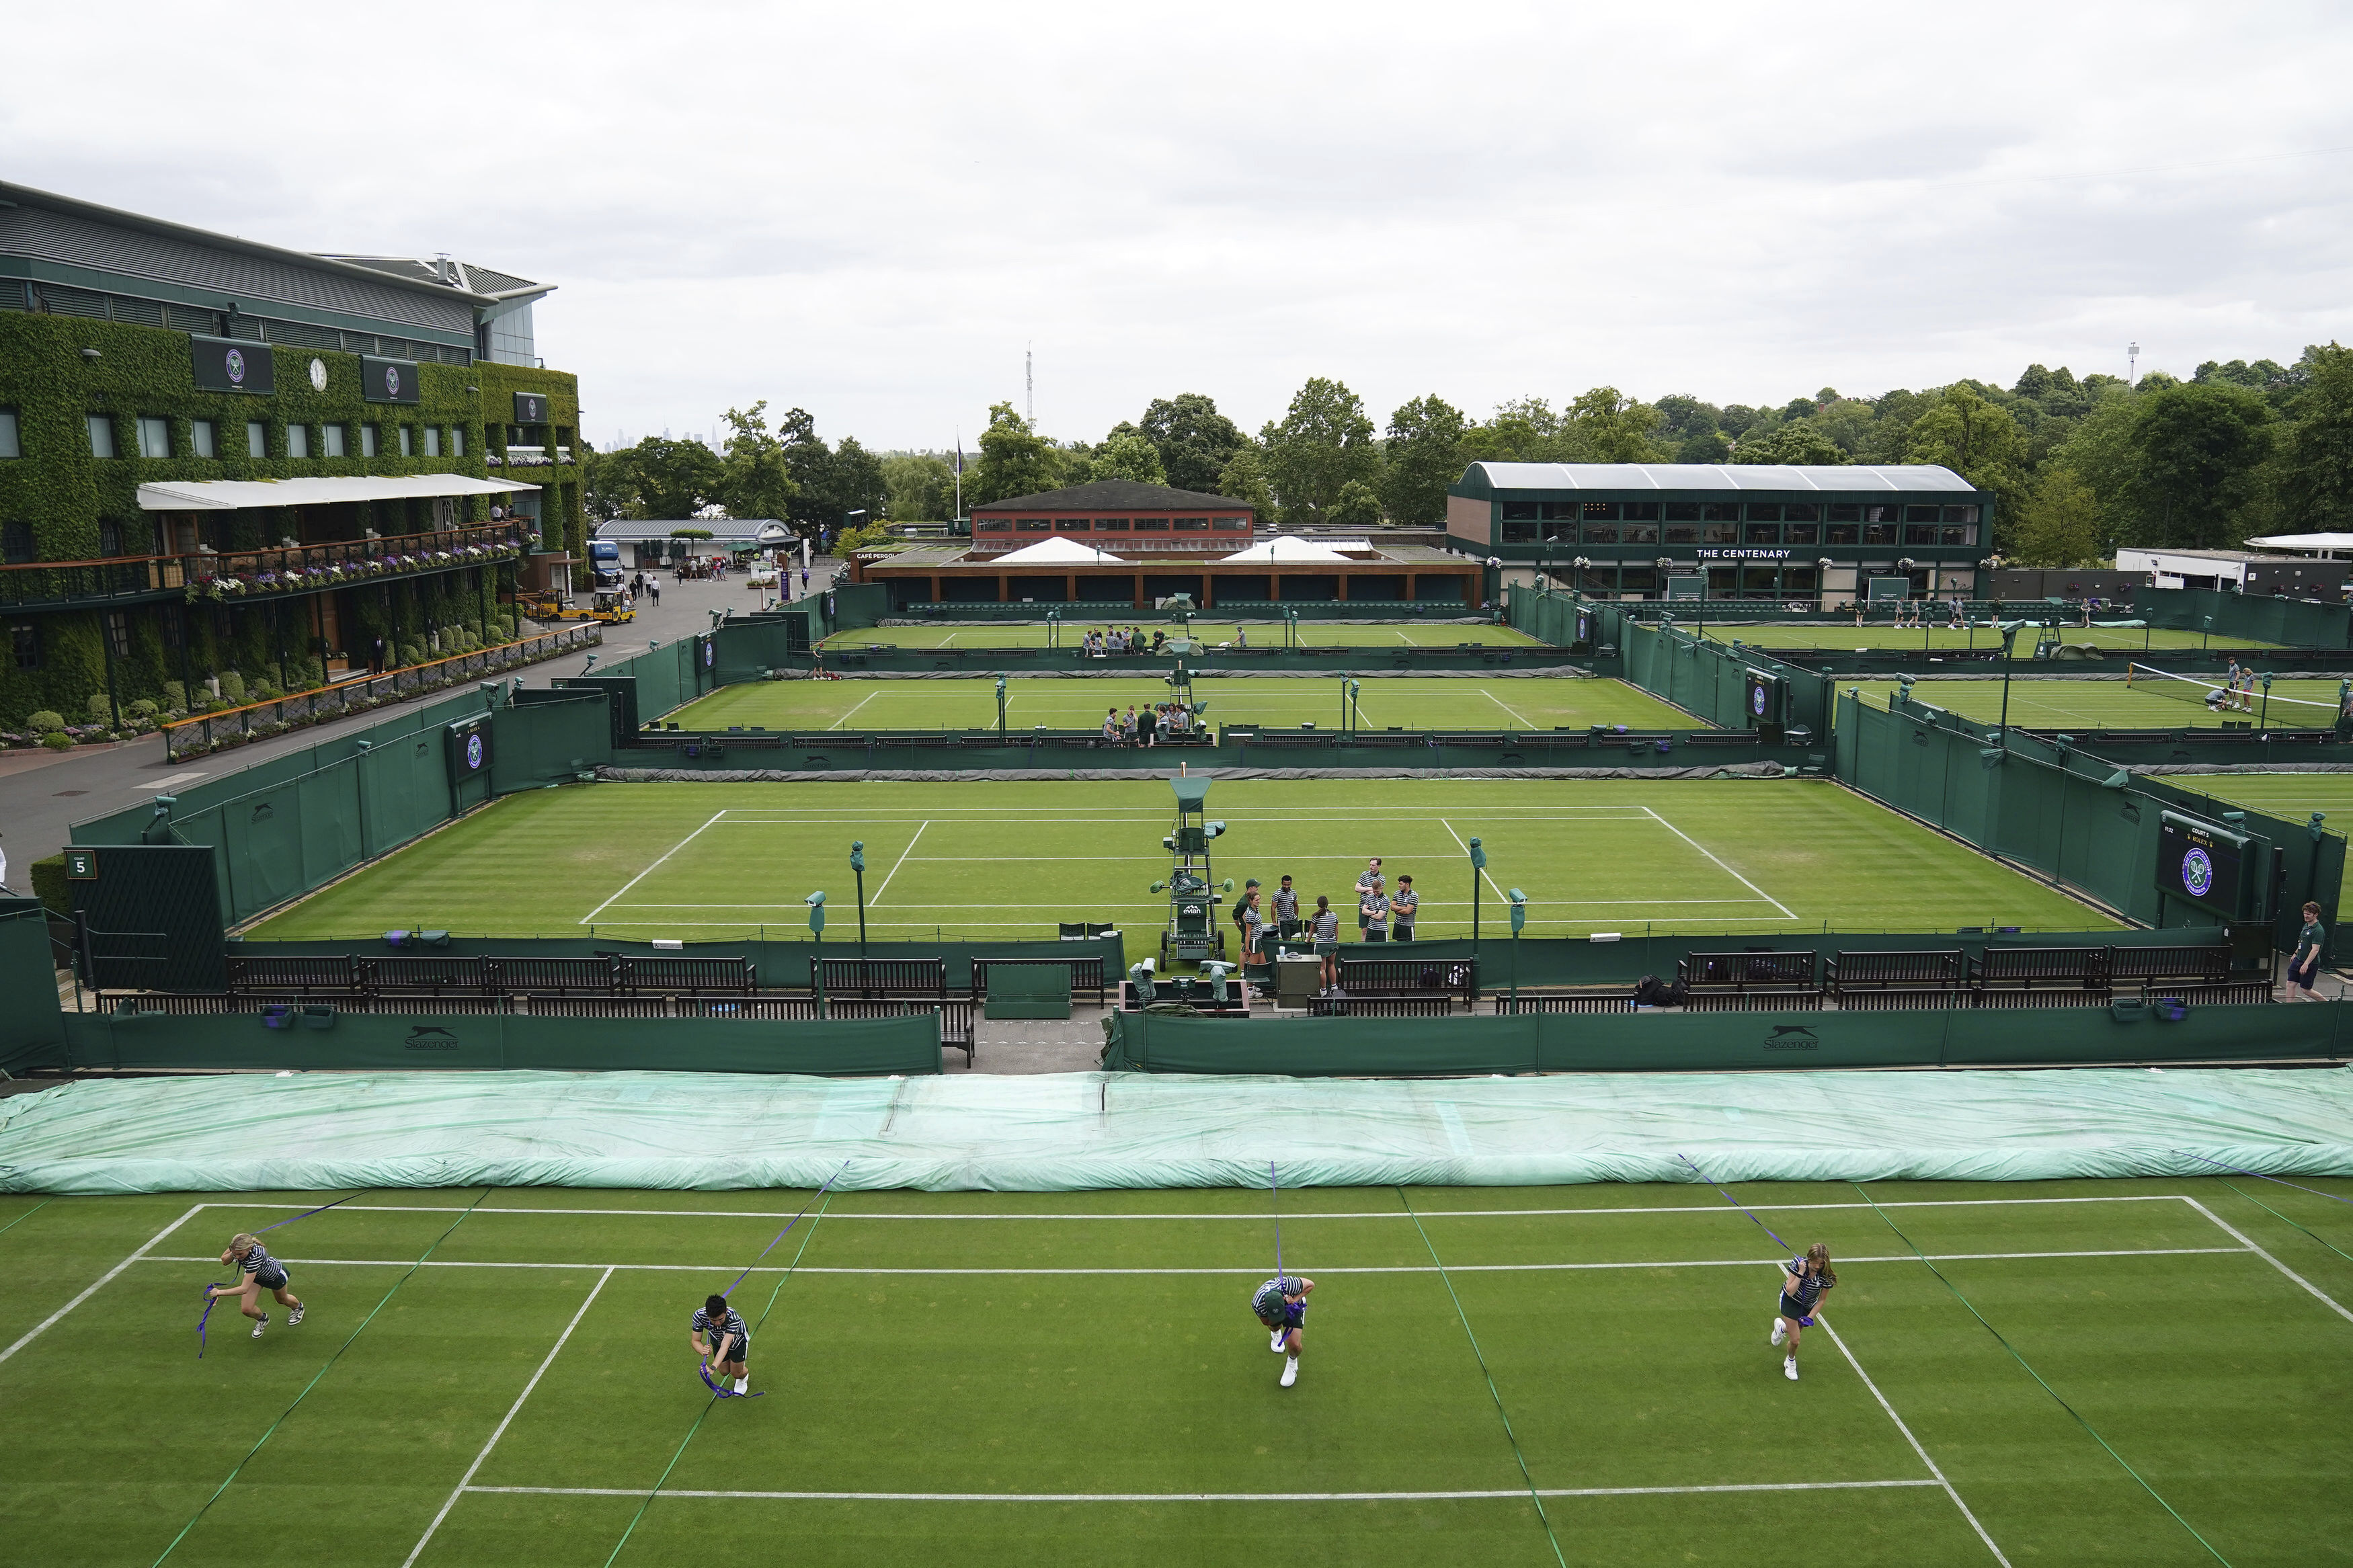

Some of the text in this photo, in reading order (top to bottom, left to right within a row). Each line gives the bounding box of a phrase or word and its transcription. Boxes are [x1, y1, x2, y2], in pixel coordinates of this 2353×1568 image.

[1696, 549, 1790, 559] THE CENTENARY
[2192, 827, 2206, 837] COURT
[2192, 836, 2208, 846] ROLEX
[77, 862, 85, 873] 5
[2188, 850, 2211, 876] CHAMPIONSHIPS
[2186, 879, 2206, 894] WIMBLEDON
[405, 1038, 458, 1050] Slazenger
[1763, 1039, 1819, 1051] Slazenger
